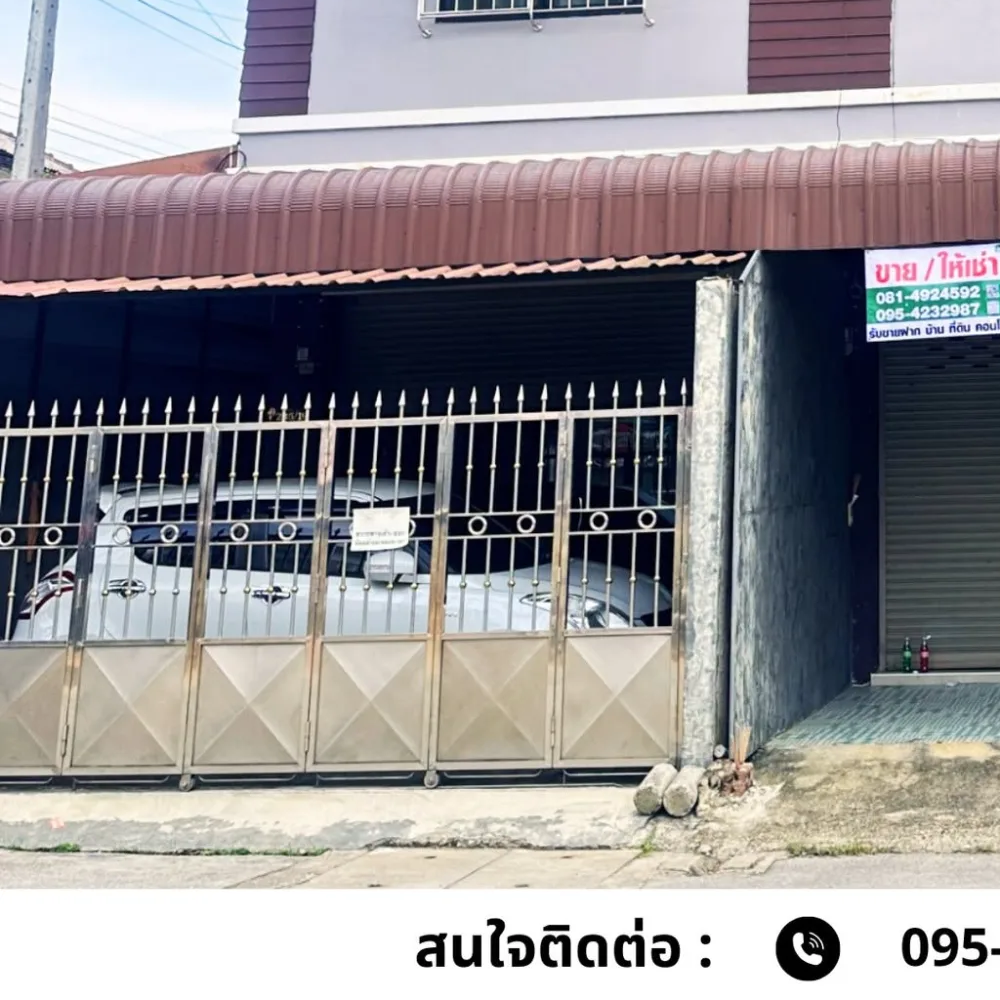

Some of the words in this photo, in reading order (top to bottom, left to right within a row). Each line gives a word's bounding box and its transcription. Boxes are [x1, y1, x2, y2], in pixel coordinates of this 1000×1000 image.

[875, 262, 917, 283] ขาย
[937, 251, 998, 279] ให้เช่า
[876, 286, 980, 304] 081-4924592
[876, 303, 980, 321] 095-4232987
[869, 325, 921, 339] รับขายฝาก
[926, 323, 944, 335] บ้าน
[949, 320, 970, 333] ที่ดิน
